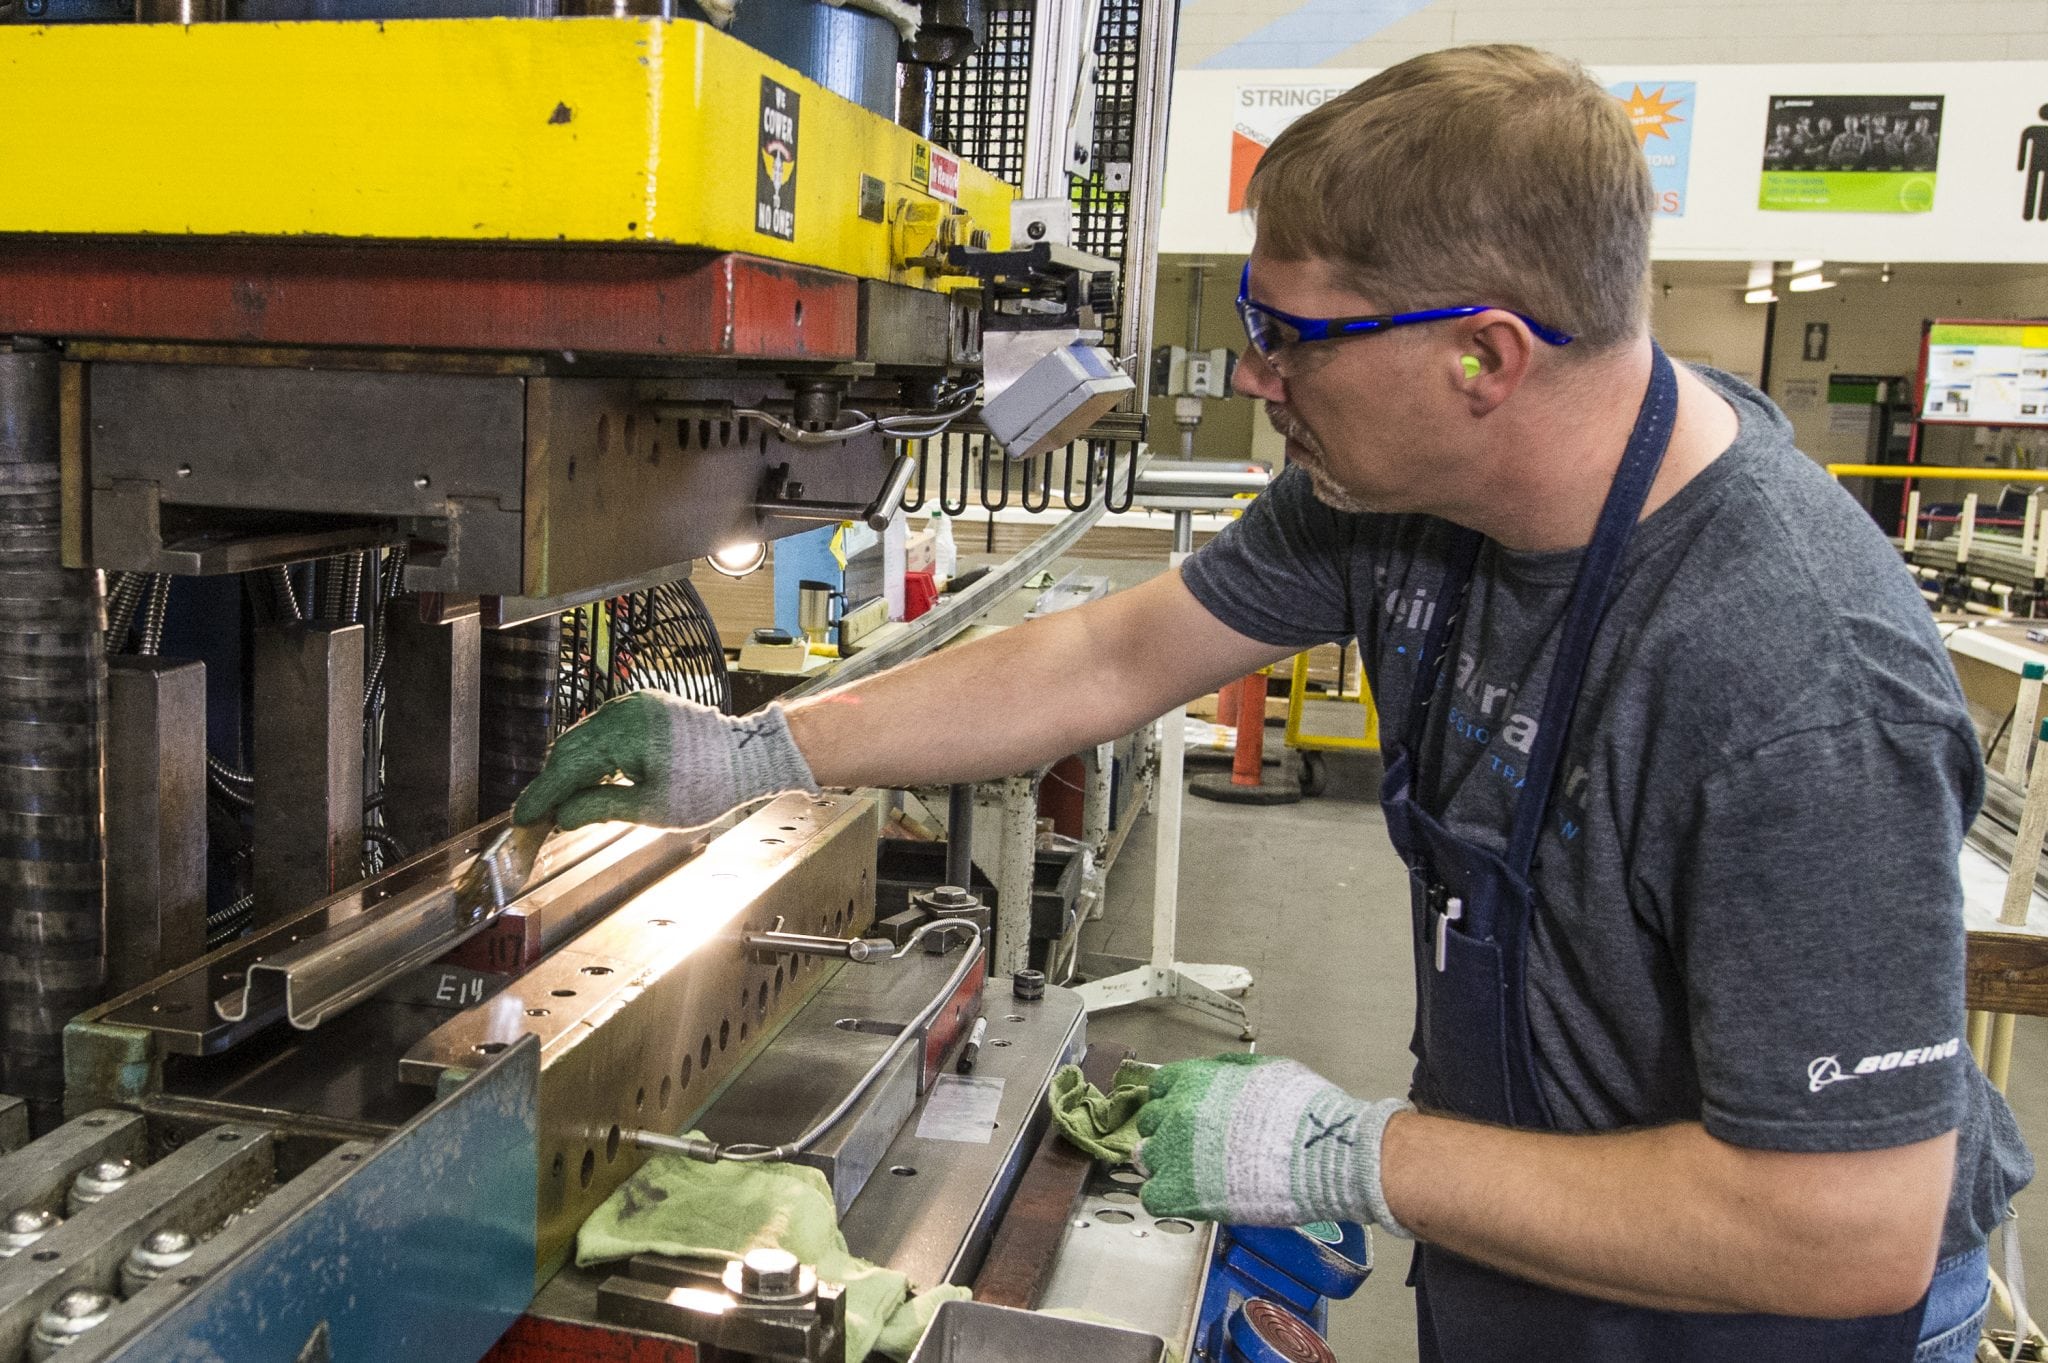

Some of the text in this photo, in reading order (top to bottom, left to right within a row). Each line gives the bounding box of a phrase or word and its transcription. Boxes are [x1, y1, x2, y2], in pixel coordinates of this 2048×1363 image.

[1241, 89, 1350, 107] STRINGE
[758, 202, 772, 230] NO
[436, 973, 484, 1005] E14
[1853, 1037, 1960, 1074] BOEING
